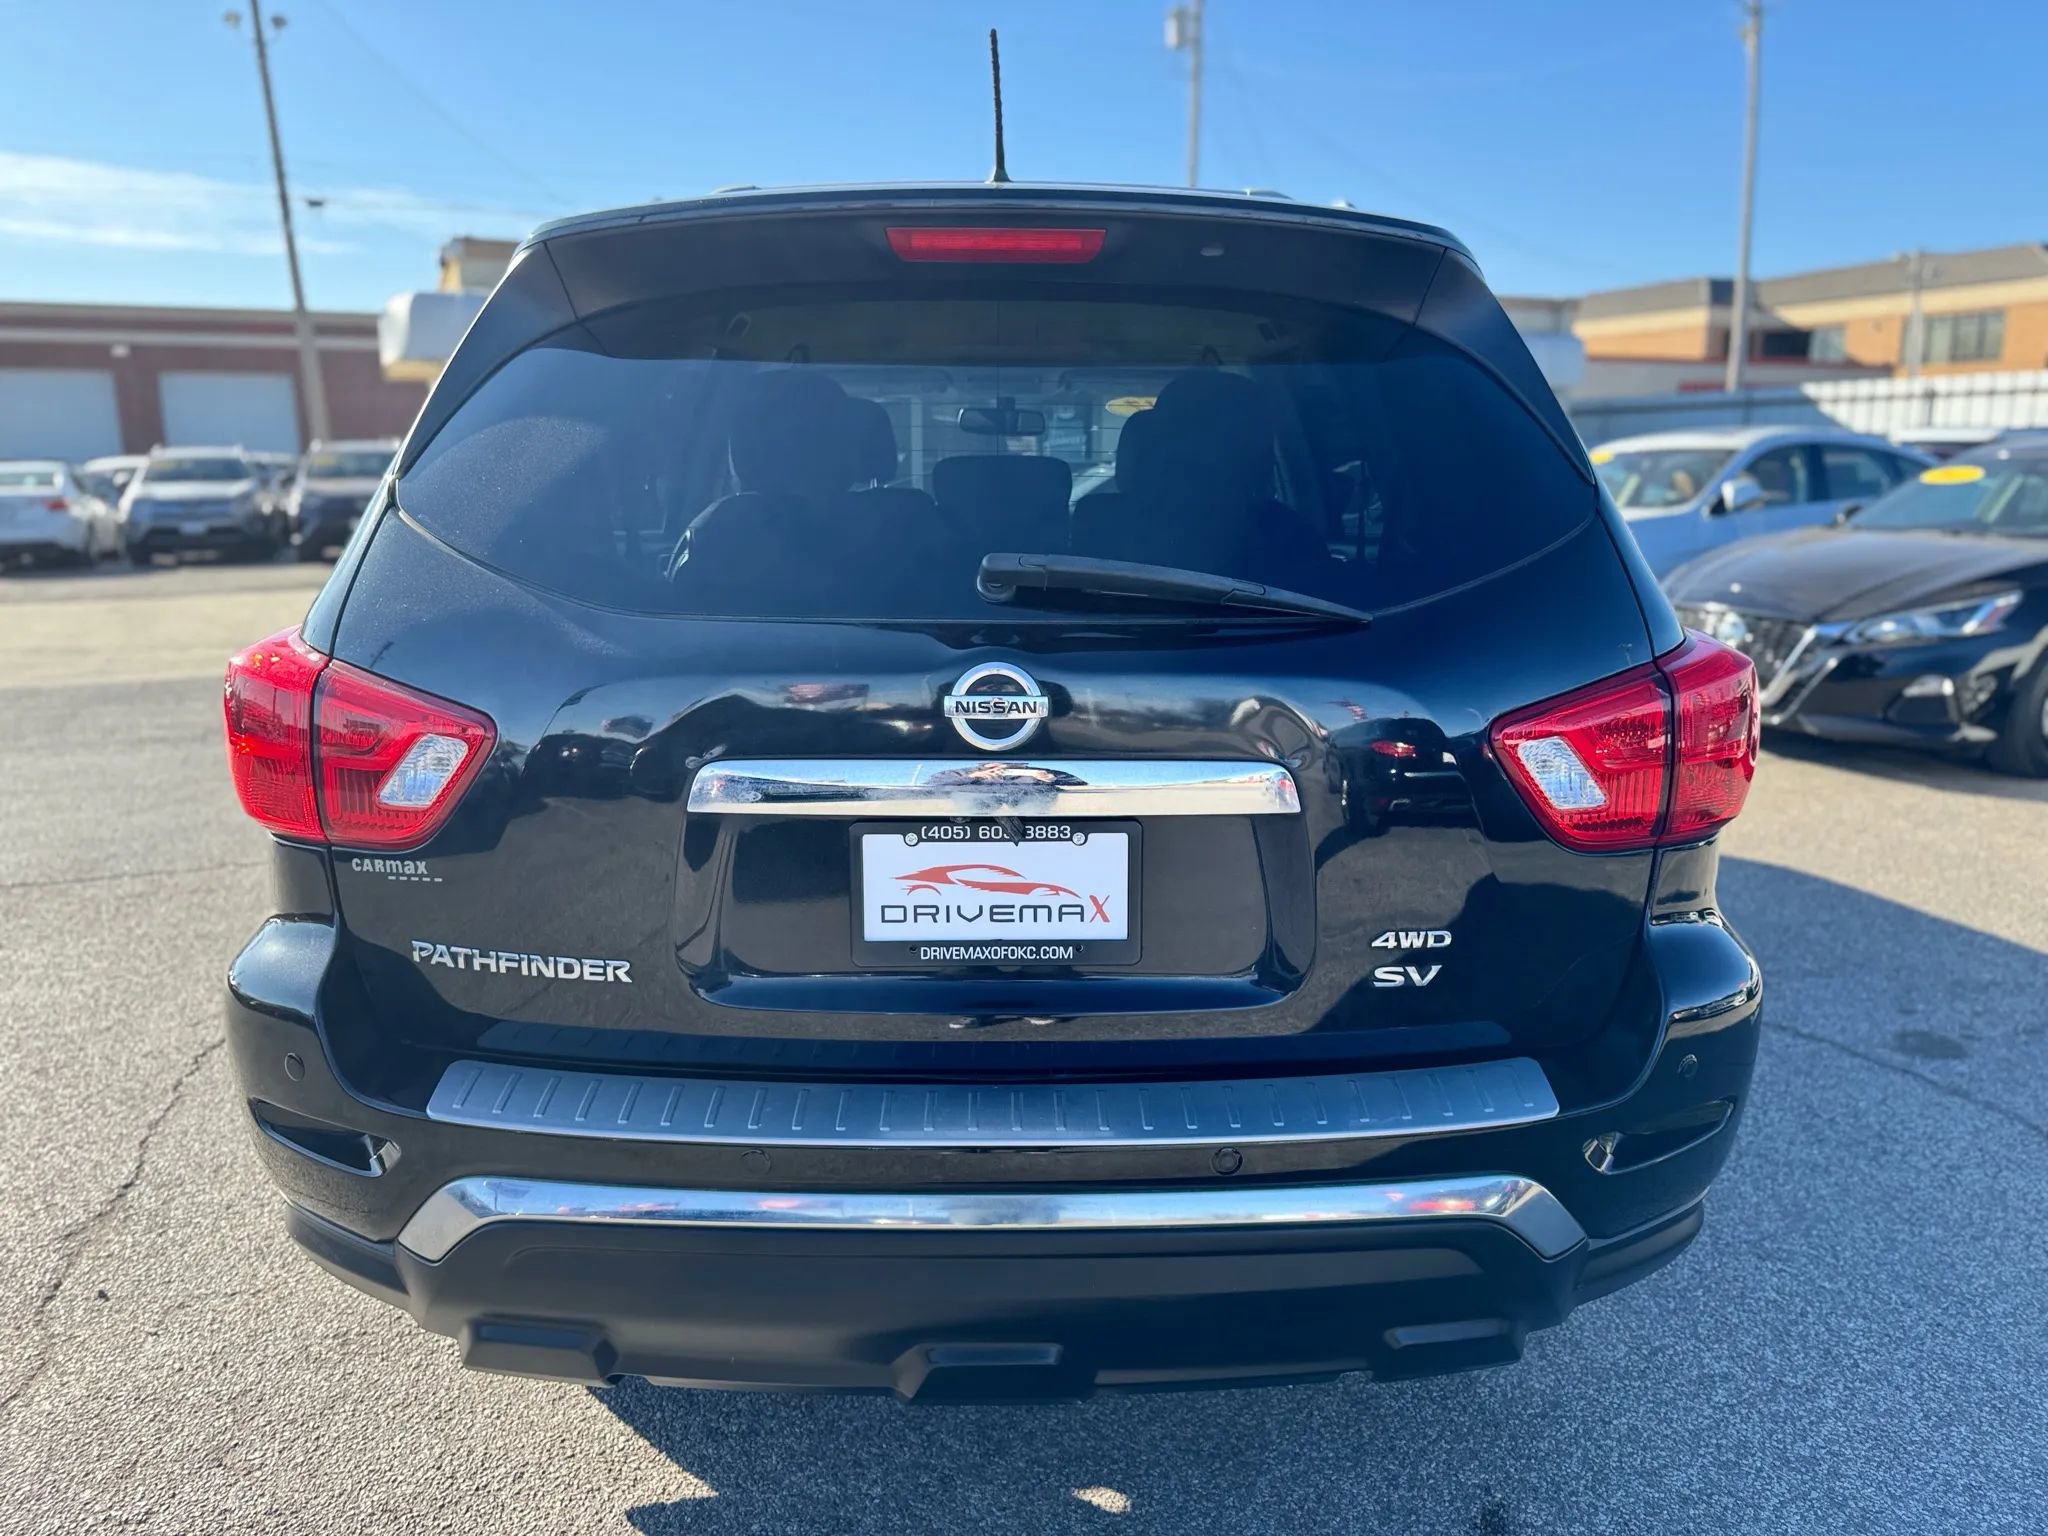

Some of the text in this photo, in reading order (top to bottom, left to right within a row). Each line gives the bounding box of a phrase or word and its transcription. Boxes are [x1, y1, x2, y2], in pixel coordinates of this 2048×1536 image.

[955, 701, 1038, 714] NISSAN
[921, 826, 971, 840] (405)
[881, 895, 1111, 924] DRIVEMAX
[1371, 930, 1452, 949] 4WD
[411, 940, 633, 984] PATHFINDER
[920, 946, 1073, 960] DRIVEMAXOFOKC.COM
[1373, 965, 1442, 988] SV
